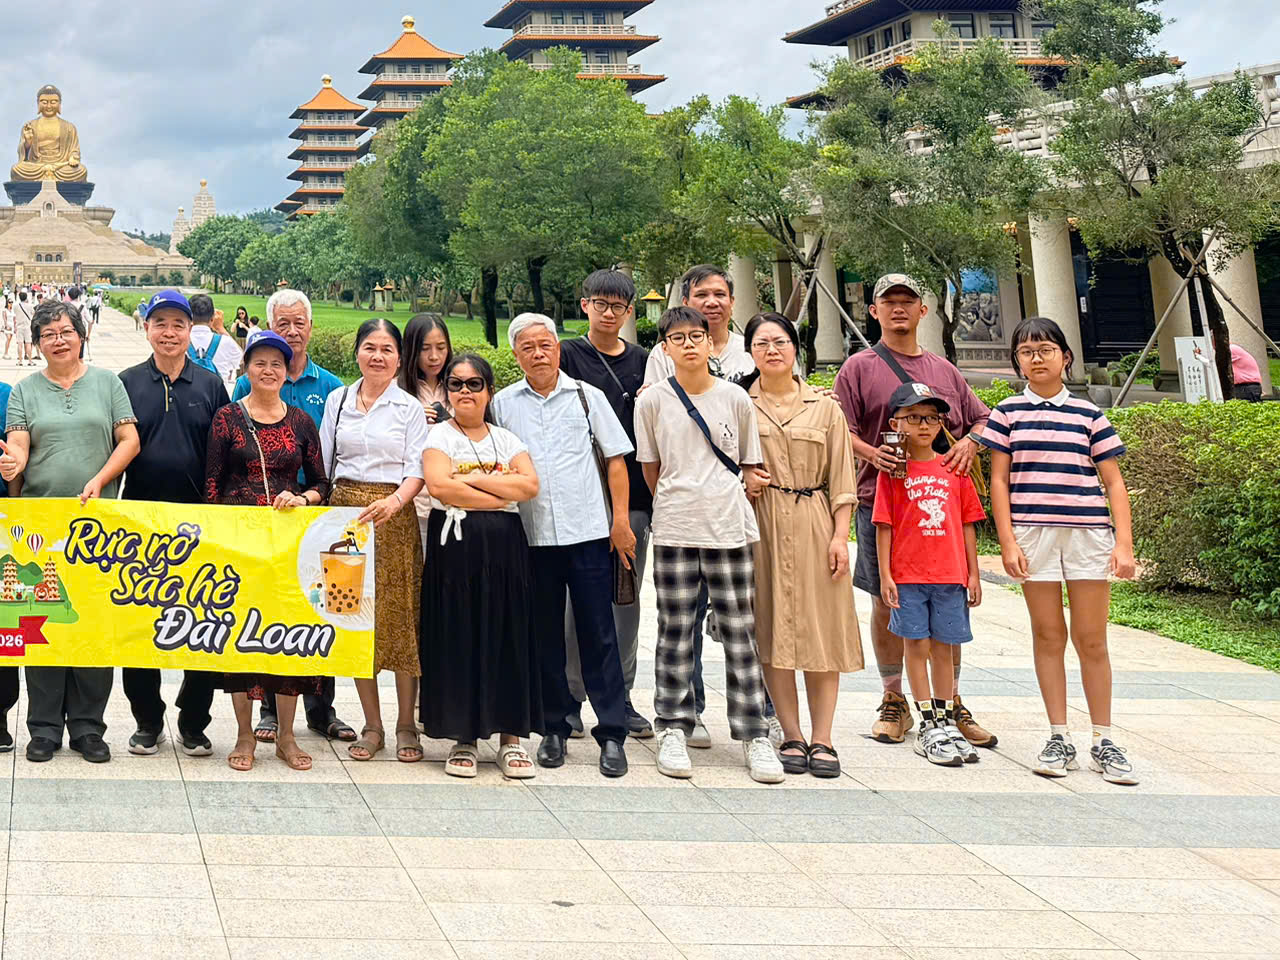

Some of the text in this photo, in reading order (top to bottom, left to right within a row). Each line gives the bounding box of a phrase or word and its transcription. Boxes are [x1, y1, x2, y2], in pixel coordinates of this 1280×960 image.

[904, 476, 937, 489] Champ
[66, 518, 200, 571] Rực rỡ
[113, 560, 240, 607] Sắc hè
[155, 606, 335, 655] Đài Loan
